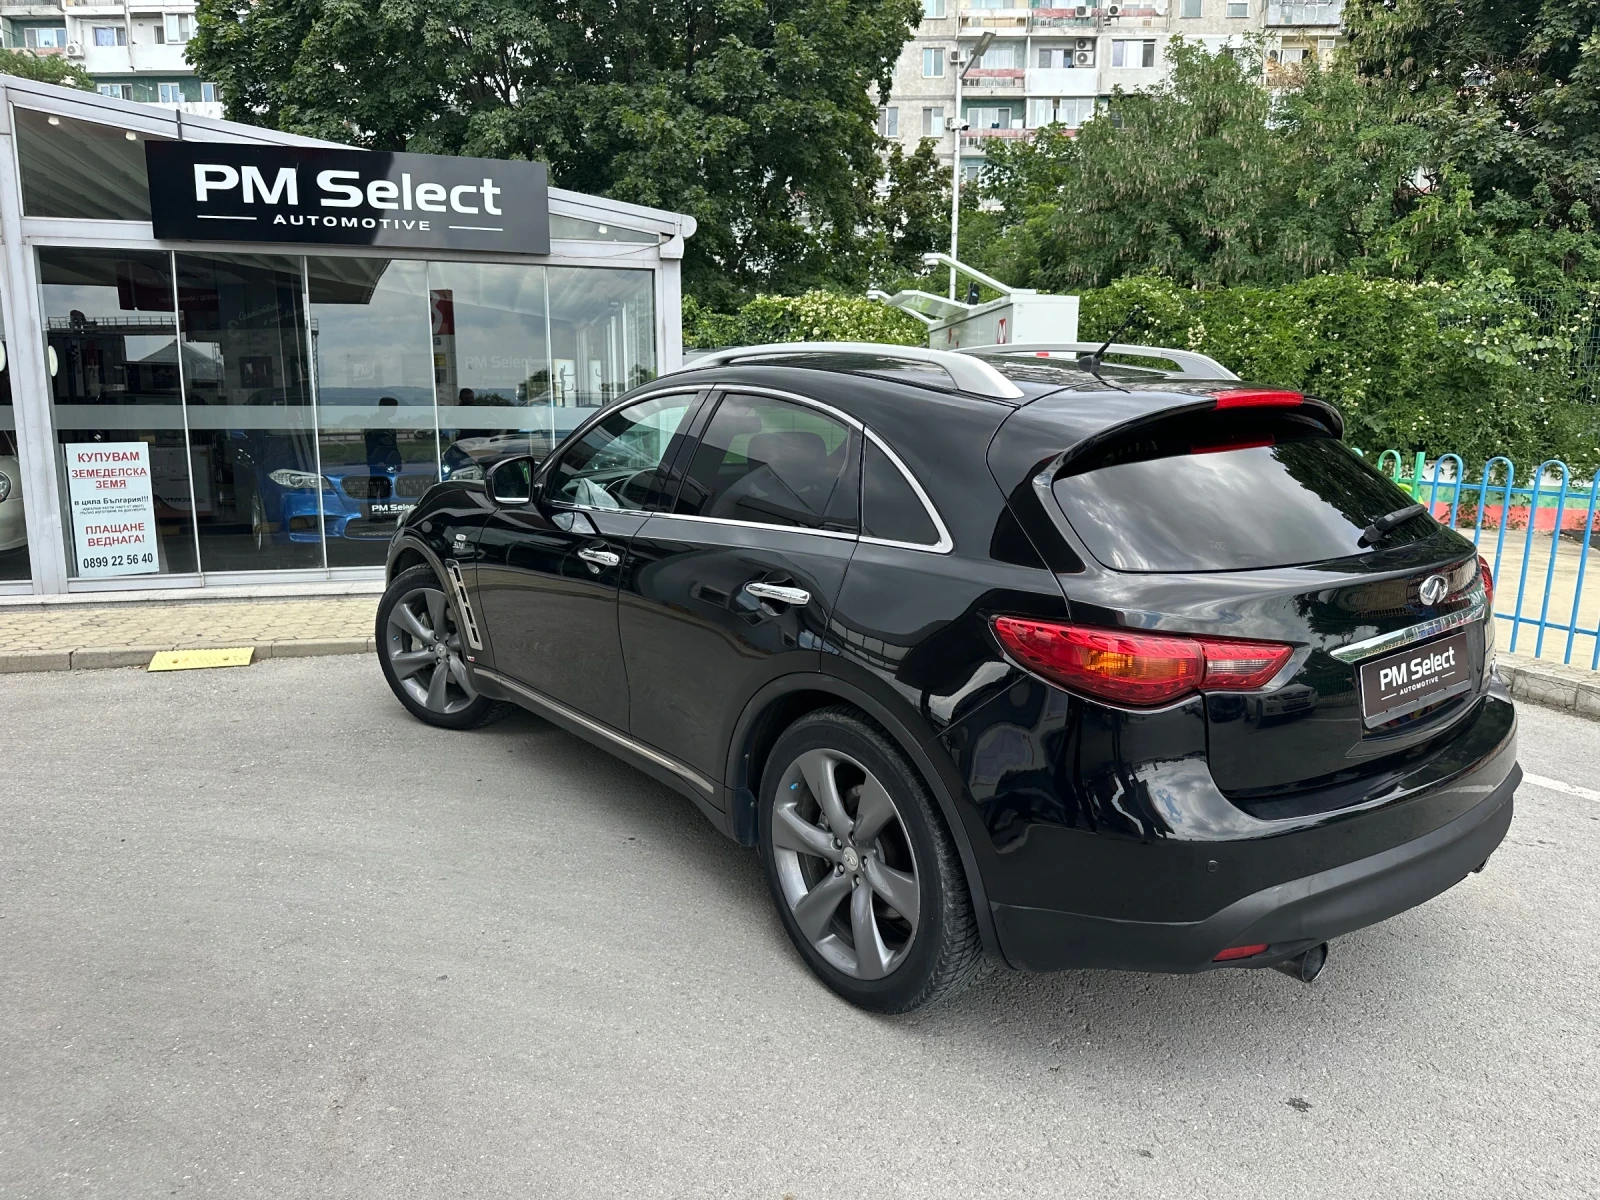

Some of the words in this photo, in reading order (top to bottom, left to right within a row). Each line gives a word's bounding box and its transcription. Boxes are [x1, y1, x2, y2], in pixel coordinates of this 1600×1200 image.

[193, 163, 299, 206] PM
[316, 169, 502, 216] Select
[273, 214, 431, 231] AUTOMOTIVE
[77, 451, 140, 463] КУПУВАМ
[71, 467, 148, 479] ЗЕМЕДЕЛСКА
[95, 479, 127, 489] ЗЕМЯ
[371, 503, 389, 512] PM
[85, 522, 145, 535] ПЛАЩАНЕ
[87, 534, 145, 547] ВЕДНАГА!
[83, 556, 108, 569] 0899
[111, 555, 124, 567] 22
[126, 553, 139, 565] 56
[141, 552, 153, 564] 40
[1379, 662, 1407, 691] PM
[1411, 646, 1456, 681] Select
[1399, 675, 1439, 696] AUTOMOTIVE
